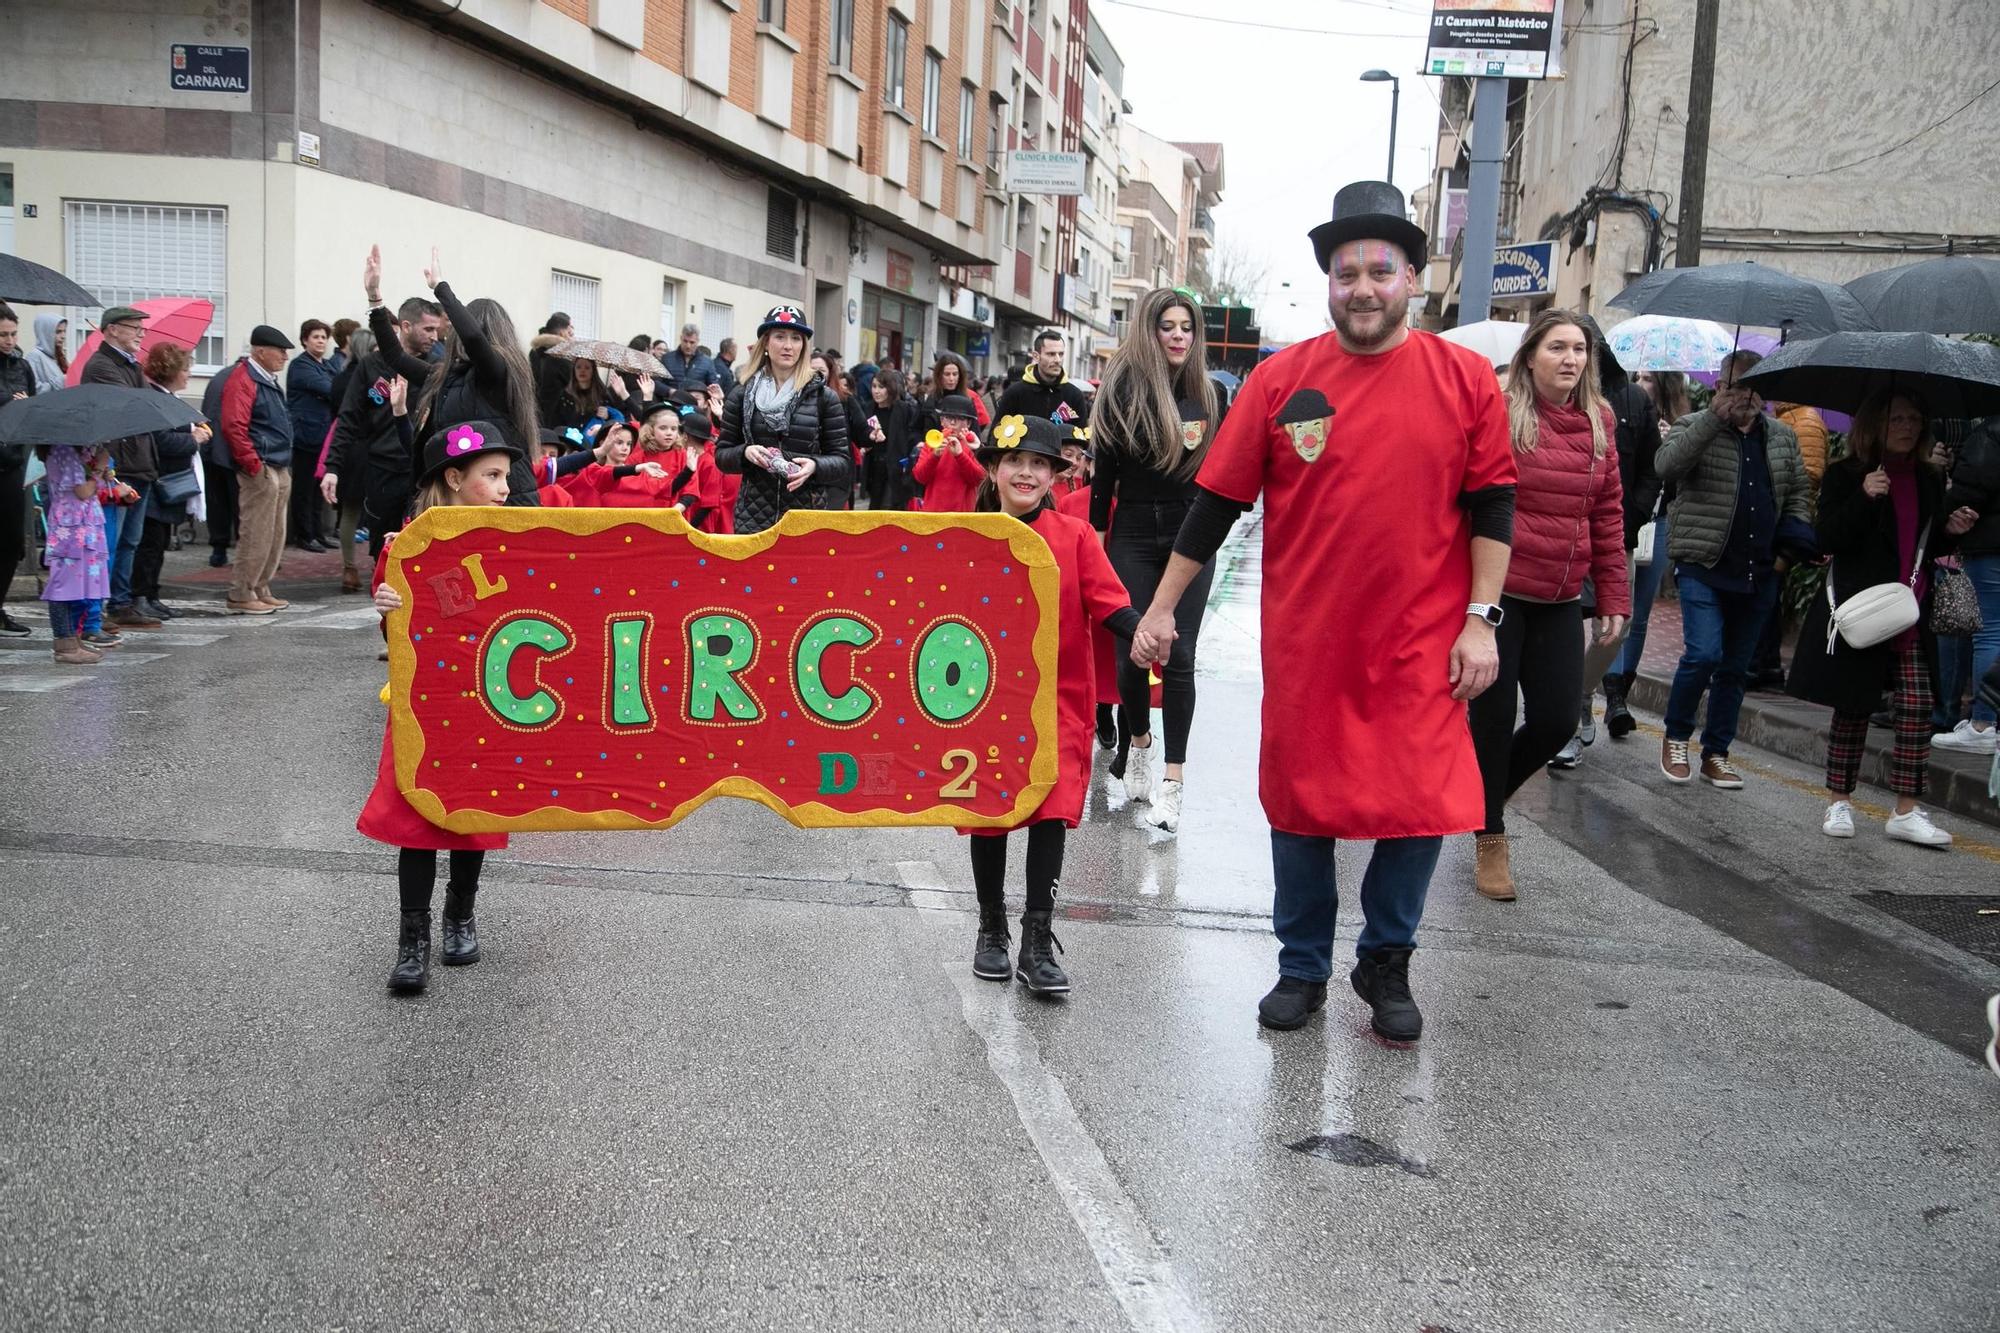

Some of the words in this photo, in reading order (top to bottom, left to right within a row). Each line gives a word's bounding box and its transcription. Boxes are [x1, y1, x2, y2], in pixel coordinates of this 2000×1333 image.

[1434, 16, 1443, 26] II
[1445, 16, 1495, 27] Carnaval
[1497, 17, 1548, 29] histórico
[197, 47, 223, 56] CALLE
[202, 66, 217, 74] DEL
[175, 74, 245, 89] CARNAVAL
[1049, 154, 1079, 163] DENTAL
[1495, 249, 1548, 290] ESCADERIA
[1493, 275, 1532, 293] OURDES
[427, 552, 508, 619] EL
[483, 613, 991, 729] CIRCO
[817, 751, 898, 796] DE
